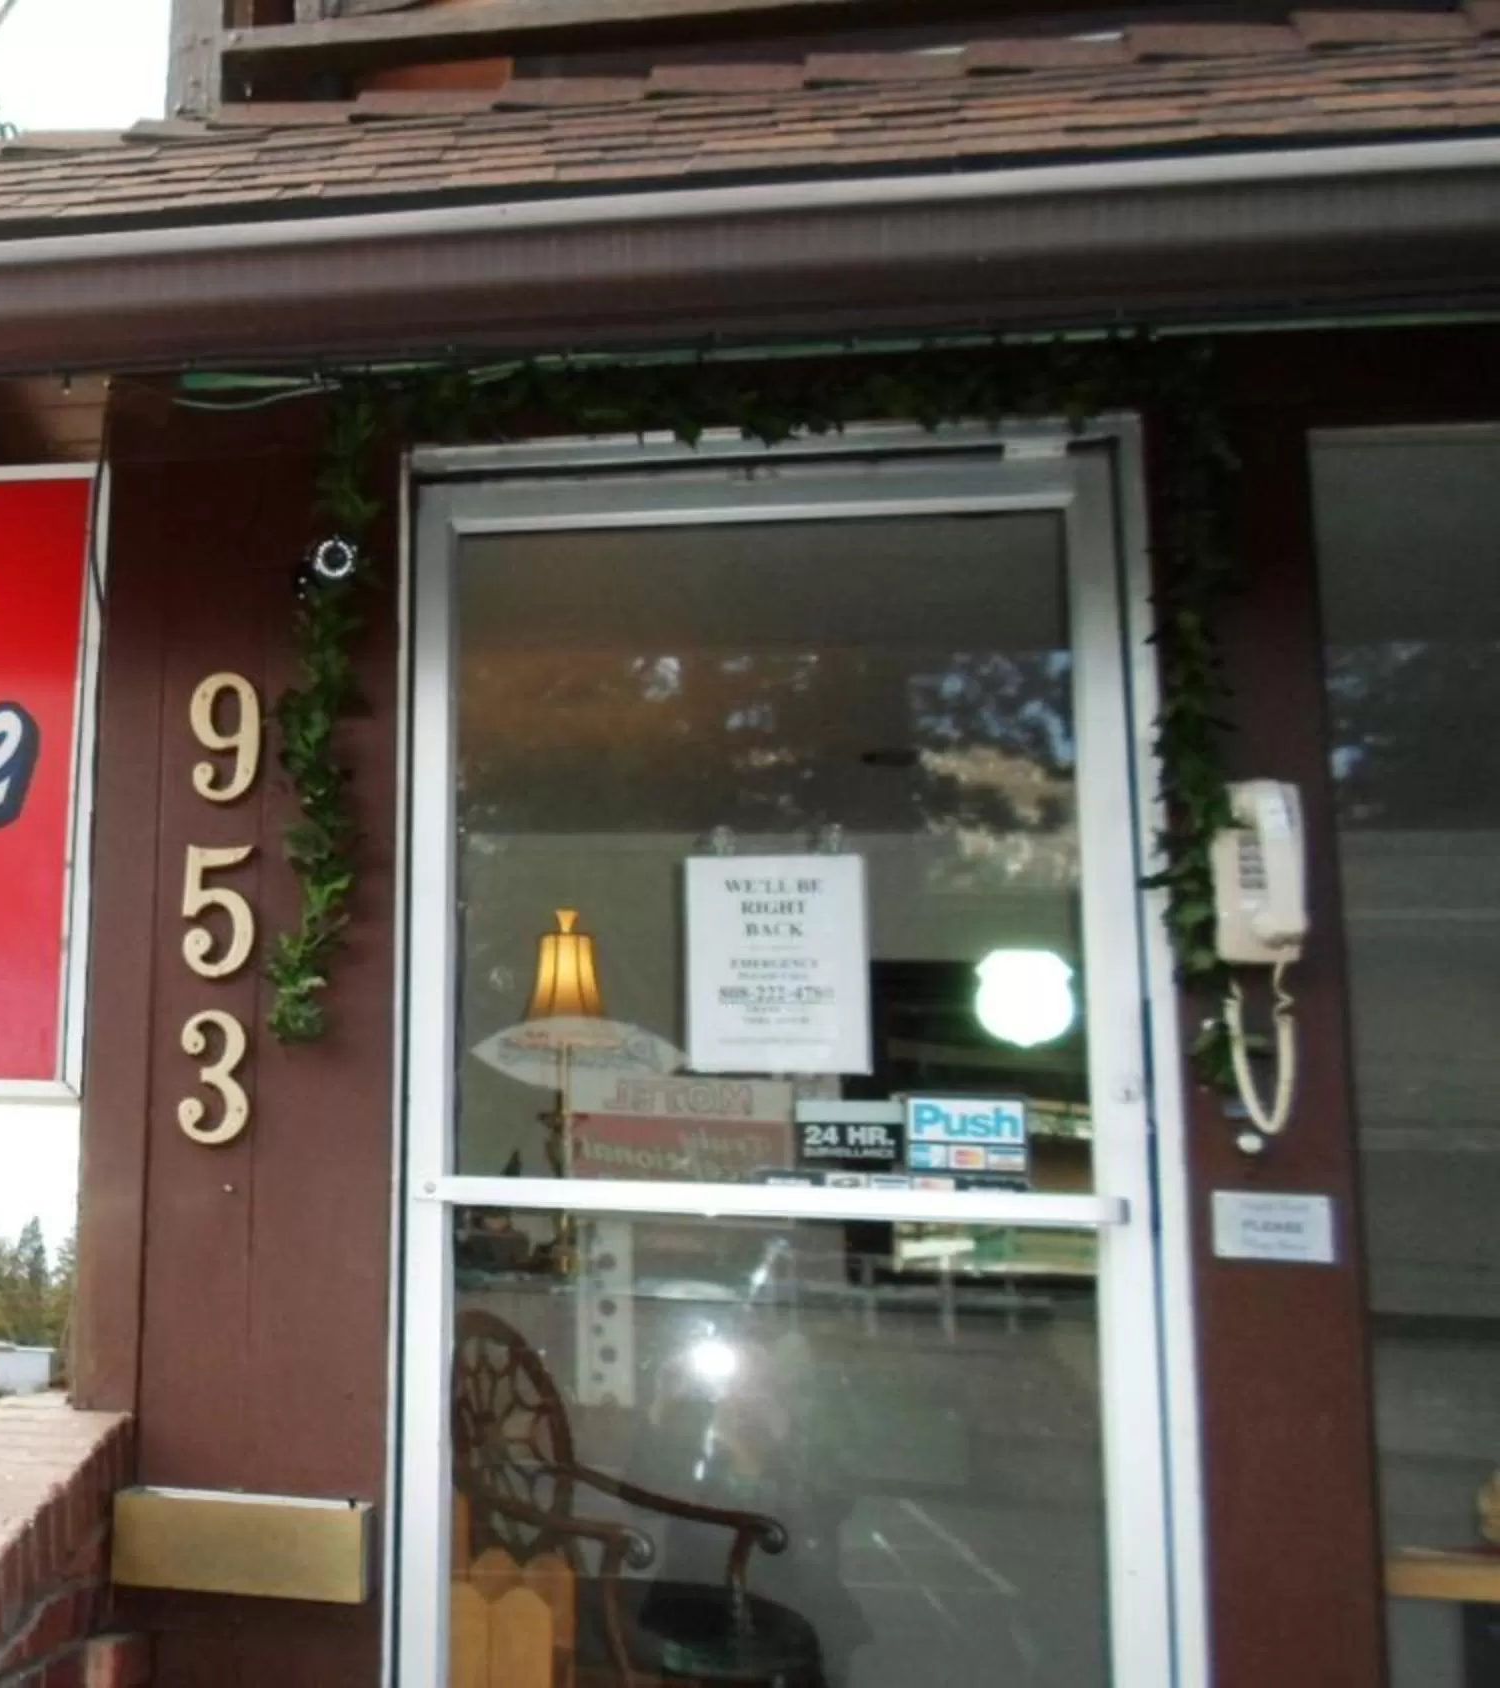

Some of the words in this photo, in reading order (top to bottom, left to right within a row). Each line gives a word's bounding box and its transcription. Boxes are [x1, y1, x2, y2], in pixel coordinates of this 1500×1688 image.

[723, 879, 787, 895] WE'LL
[796, 879, 822, 895] BE
[740, 899, 806, 915] RIGHT
[745, 922, 804, 938] BACK
[913, 1103, 1021, 1139] Push
[803, 1124, 840, 1146] 24
[846, 1125, 896, 1147] HR.
